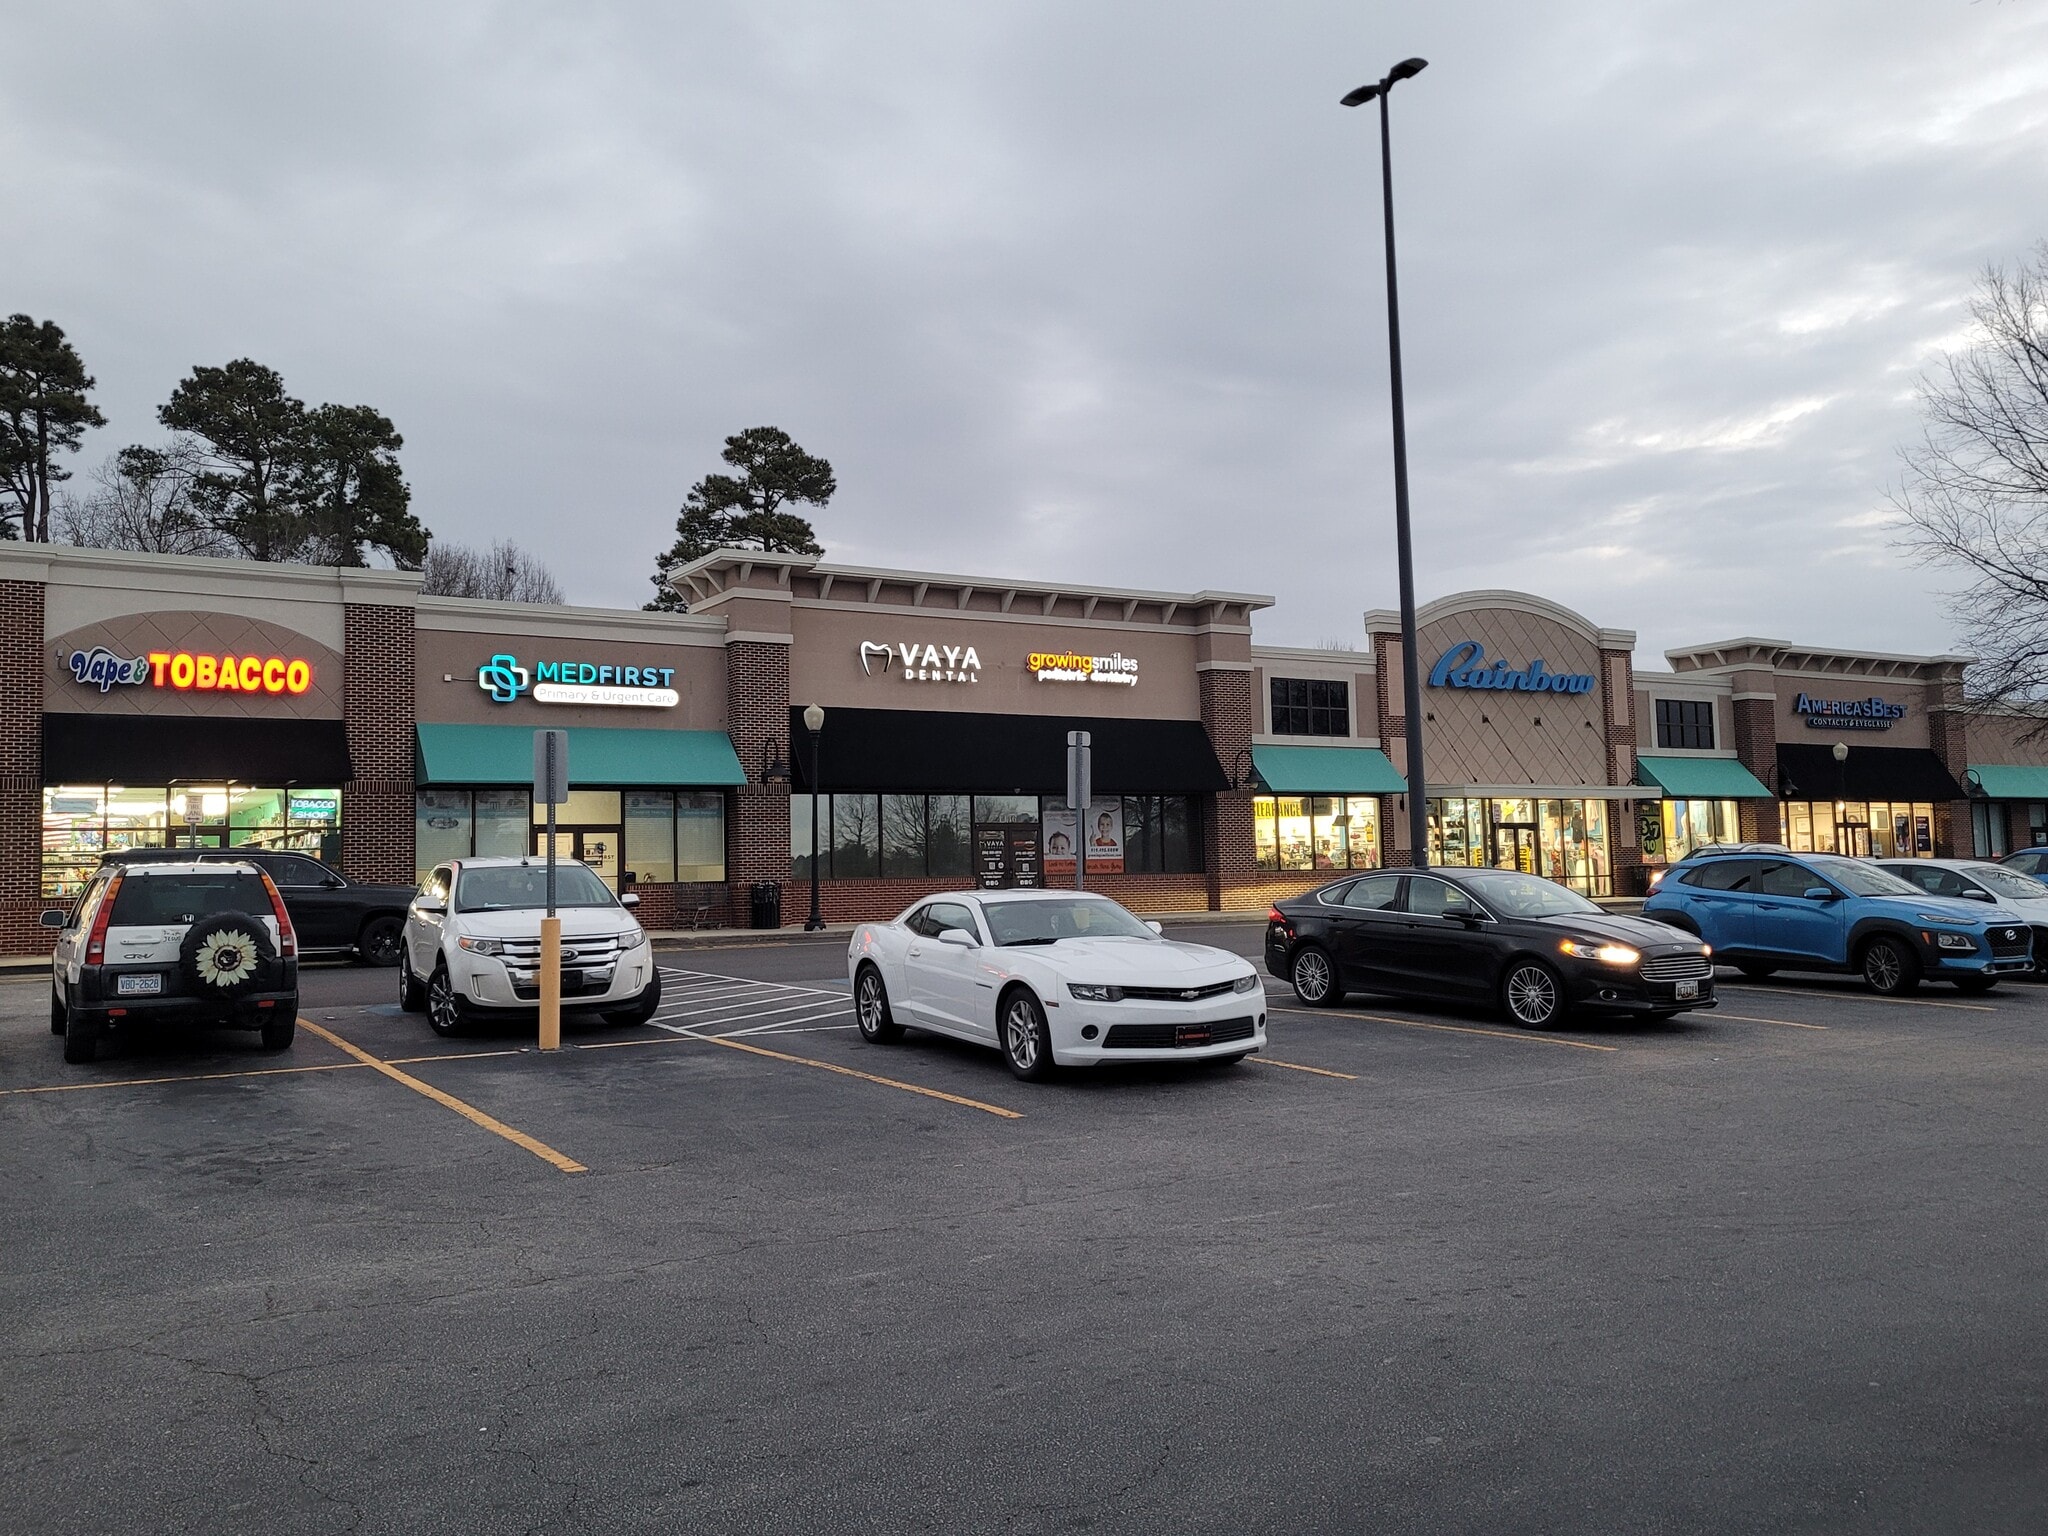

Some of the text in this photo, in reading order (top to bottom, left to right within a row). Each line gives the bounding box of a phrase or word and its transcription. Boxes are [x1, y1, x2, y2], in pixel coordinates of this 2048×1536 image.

[898, 643, 982, 669] VAYA
[1028, 651, 1138, 673] growingsmiles
[71, 650, 311, 694] Vape & TOBACCO
[537, 661, 675, 687] MEDFIRST
[1430, 640, 1595, 694] Rainbow
[905, 669, 978, 683] DENTAL
[540, 688, 675, 704] Primary & Urgent Care
[1813, 719, 1848, 727] CONTACTS
[1856, 720, 1894, 728] EYEGLASSES
[291, 800, 336, 809] TOBACCO
[1256, 802, 1301, 817] LEARANCE
[296, 811, 329, 819] SHOP
[120, 978, 160, 990] VBD-2628
